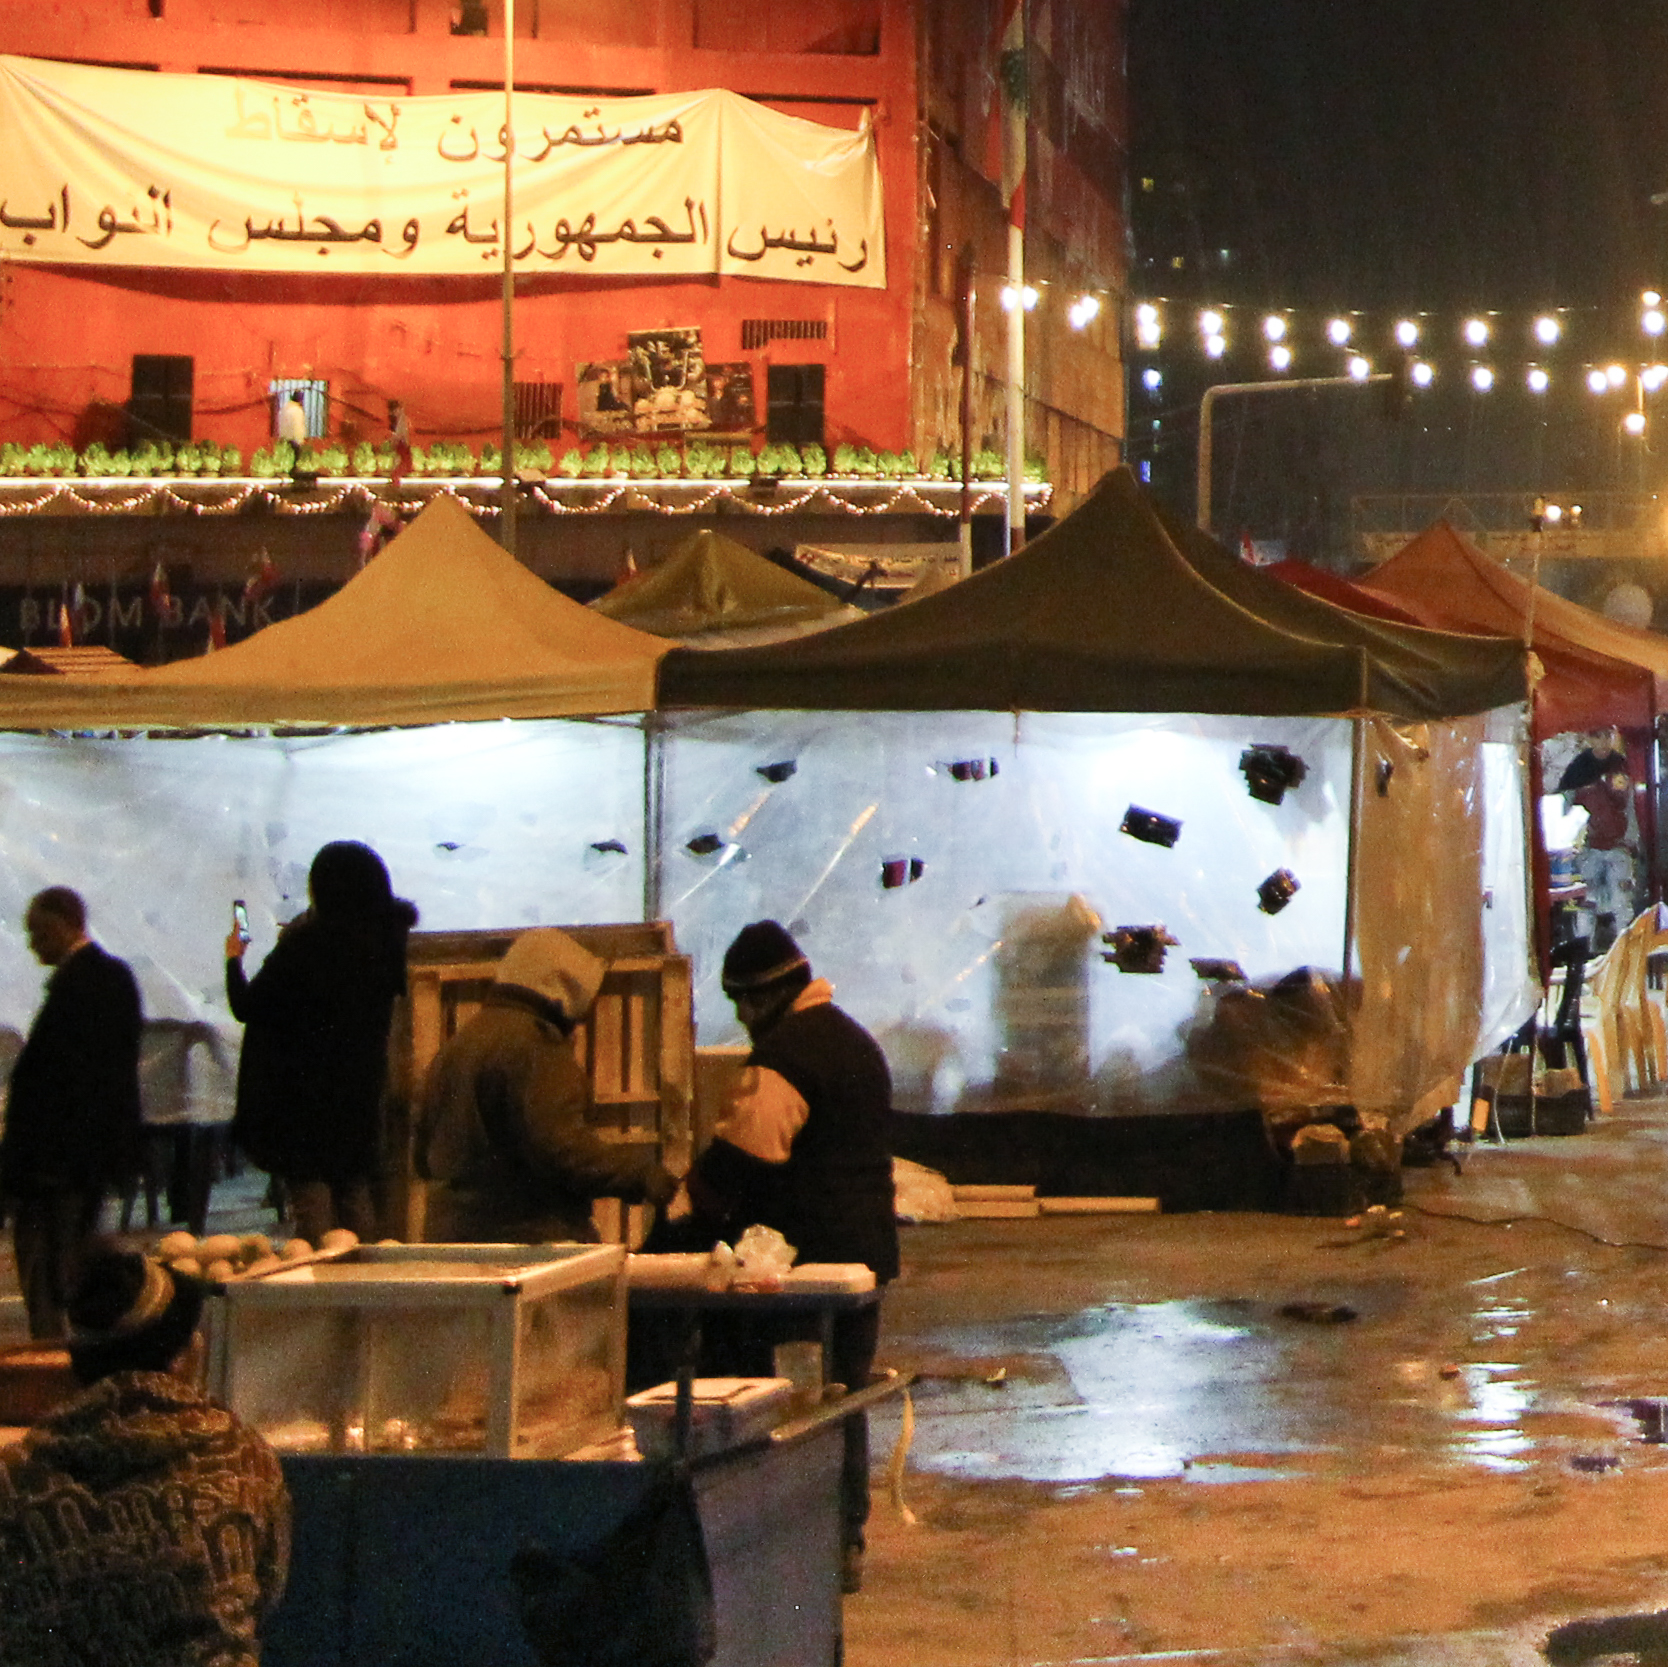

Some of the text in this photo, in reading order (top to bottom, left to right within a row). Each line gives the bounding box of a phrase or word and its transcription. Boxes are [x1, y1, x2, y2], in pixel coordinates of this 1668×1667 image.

[224, 84, 683, 165] مستمرون لإسقاط
[0, 183, 173, 250] النواب
[207, 189, 421, 260] ومجلس
[446, 187, 710, 263] الجمهورية
[19, 594, 275, 634] BLOM BANK
